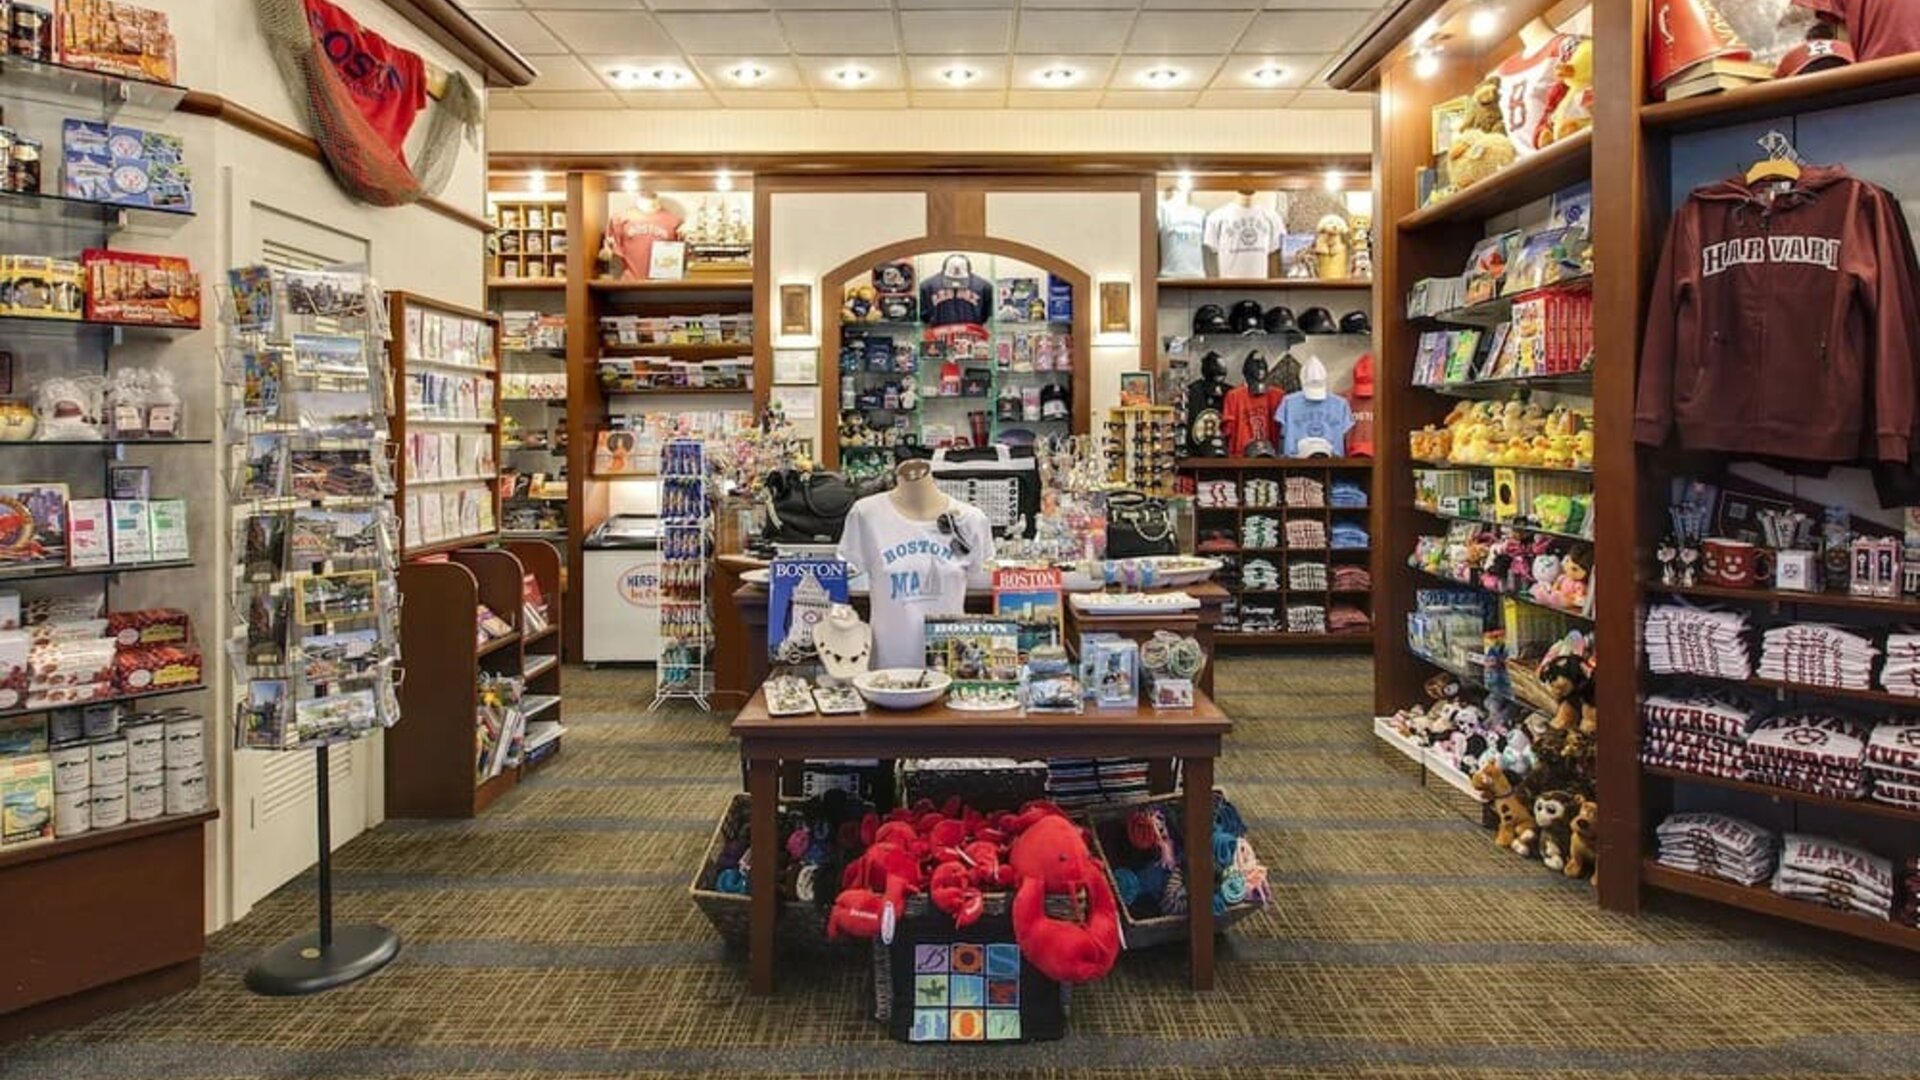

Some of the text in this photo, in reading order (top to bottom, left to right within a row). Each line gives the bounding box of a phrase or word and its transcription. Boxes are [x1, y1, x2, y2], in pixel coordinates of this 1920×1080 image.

[883, 539, 955, 565] BOSTON
[775, 563, 846, 578] BOSTON
[1000, 570, 1058, 588] BOSTON
[934, 623, 1009, 633] BOSTON
[1797, 843, 1891, 887] HARVARD
